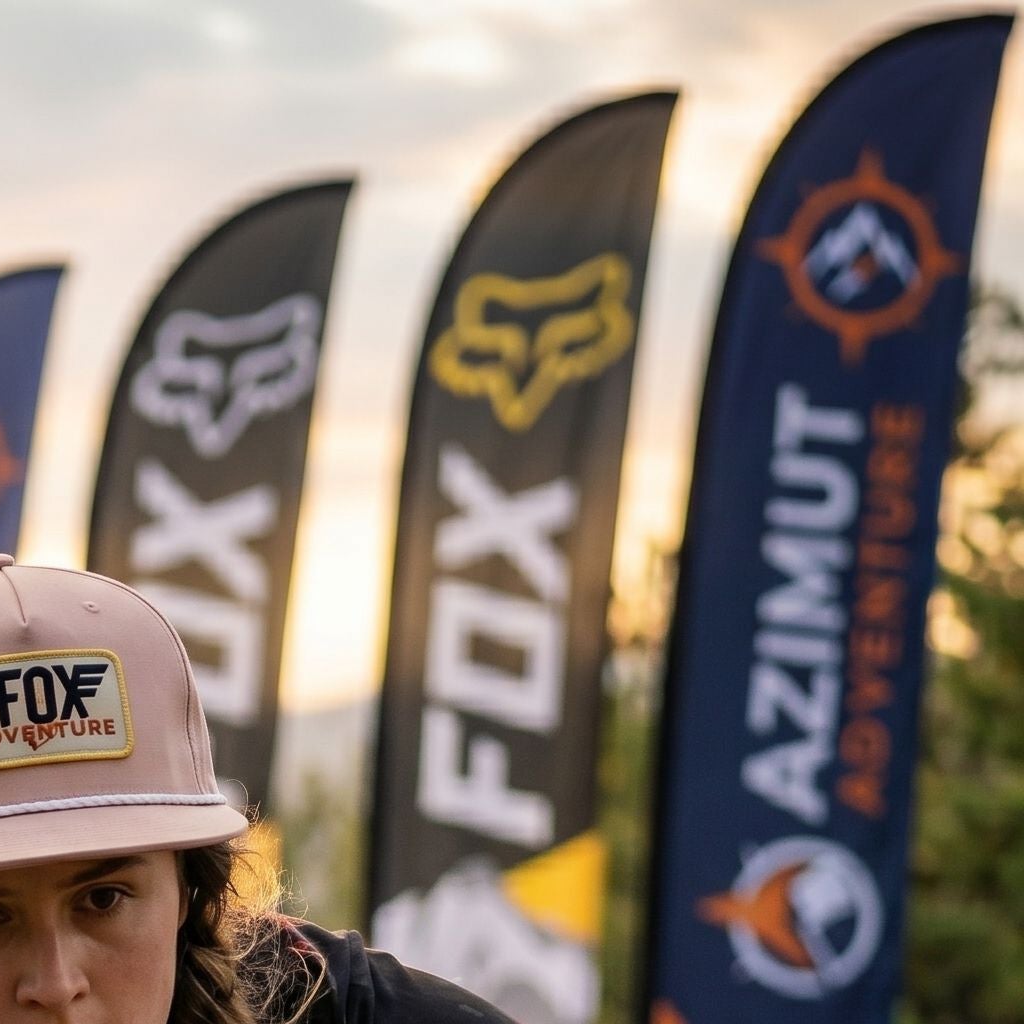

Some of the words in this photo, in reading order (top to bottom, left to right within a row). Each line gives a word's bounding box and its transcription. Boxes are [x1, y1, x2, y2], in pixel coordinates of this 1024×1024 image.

[129, 459, 277, 728] OX
[416, 444, 577, 847] FOX
[740, 384, 866, 826] AZIMUT
